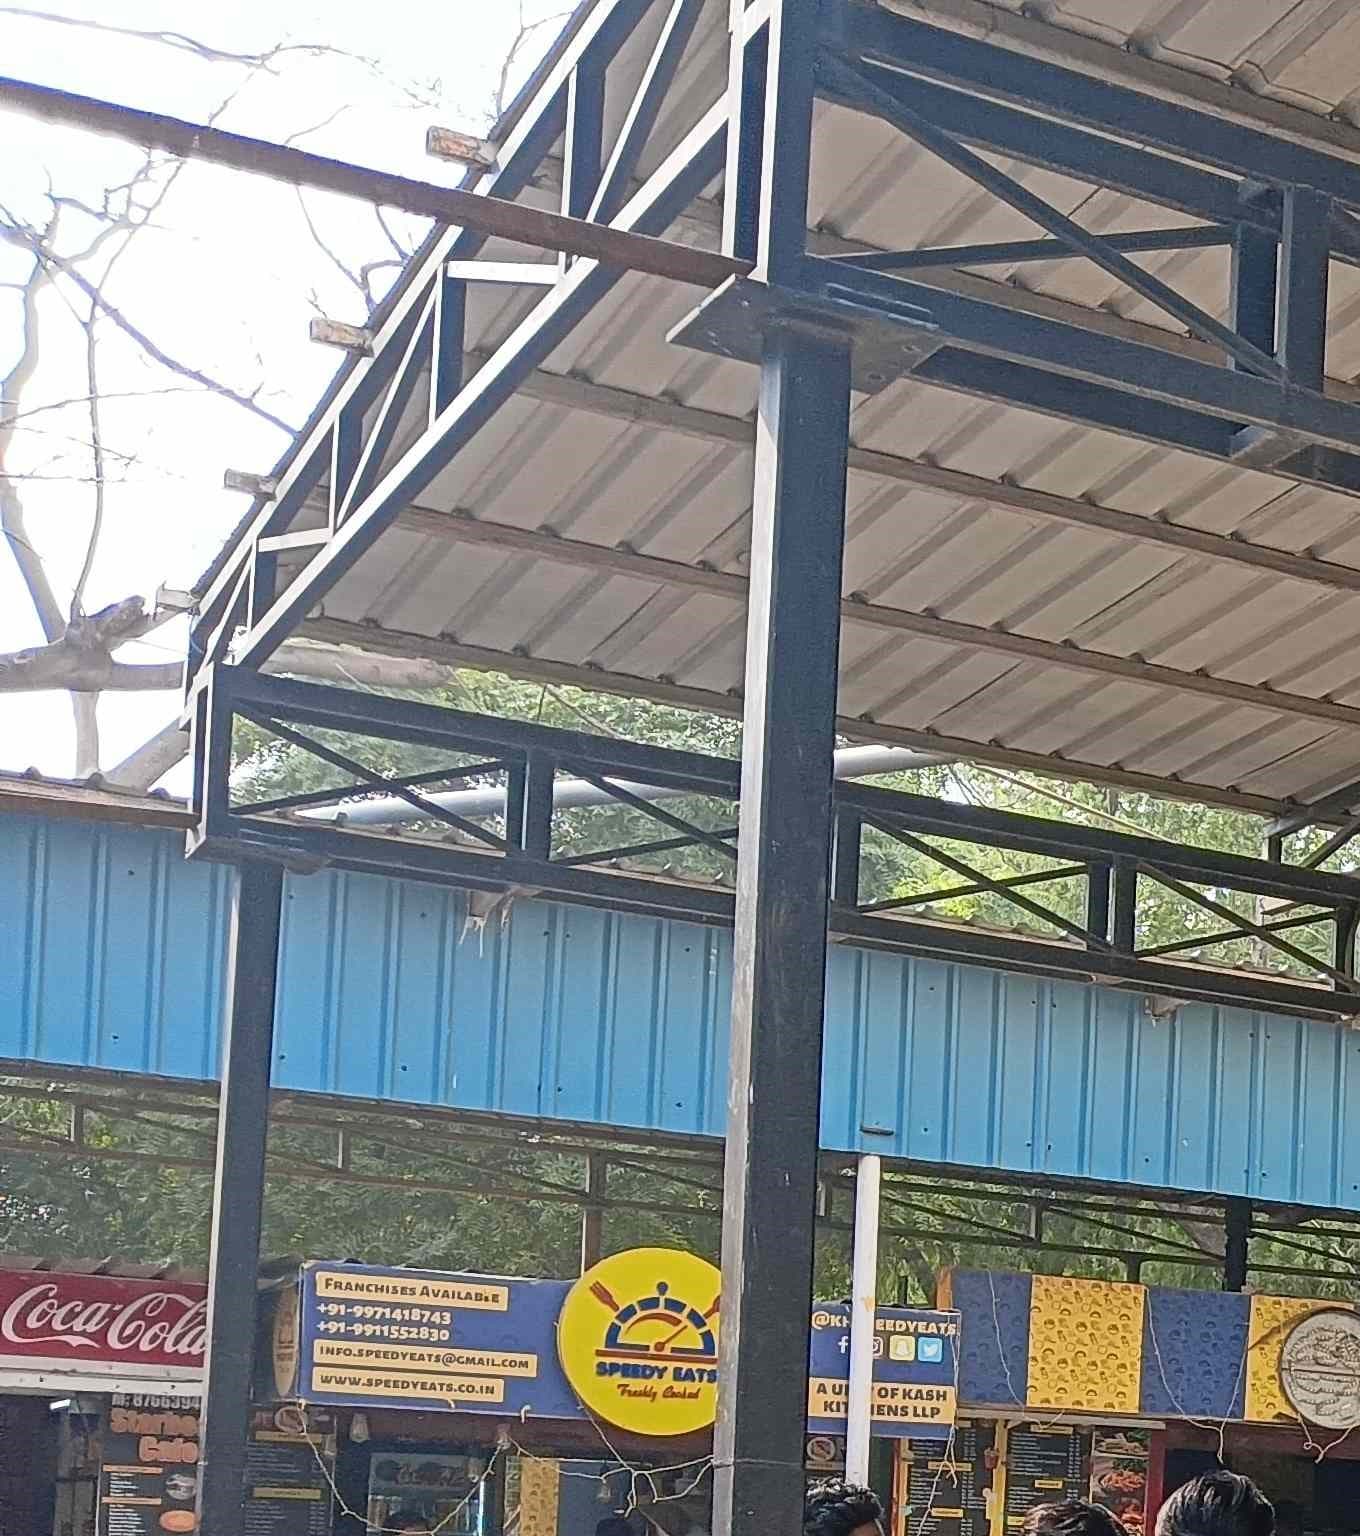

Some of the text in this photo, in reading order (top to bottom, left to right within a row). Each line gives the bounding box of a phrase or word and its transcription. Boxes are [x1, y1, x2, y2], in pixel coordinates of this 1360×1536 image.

[2, 1283, 207, 1355] Coca-Cola
[317, 1302, 452, 1325] +91-9971418743
[317, 1321, 450, 1341] +91-9911552830
[596, 1362, 717, 1384] SPEEDY EATS
[662, 1385, 701, 1400] Cooked
[817, 1383, 828, 1394] A
[877, 1387, 899, 1399] OF
[902, 1388, 948, 1402] KASH
[824, 1400, 941, 1419] KITENS LLP
